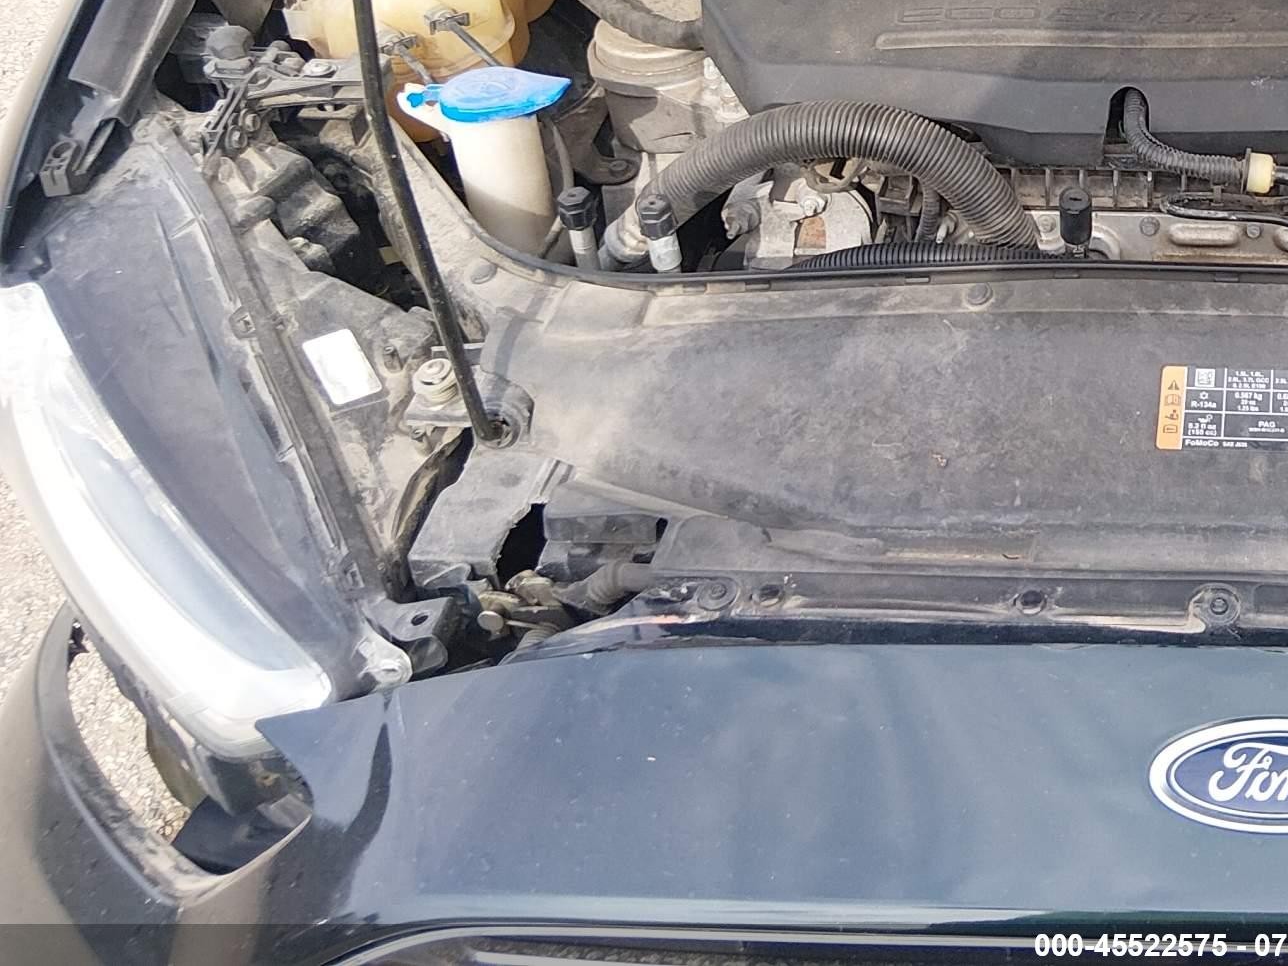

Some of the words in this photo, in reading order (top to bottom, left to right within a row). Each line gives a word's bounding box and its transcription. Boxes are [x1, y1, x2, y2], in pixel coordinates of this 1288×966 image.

[1253, 392, 1263, 402] kg
[1190, 400, 1217, 409] R-134a
[1257, 420, 1276, 429] PAG
[1185, 439, 1220, 447] FoMoCo
